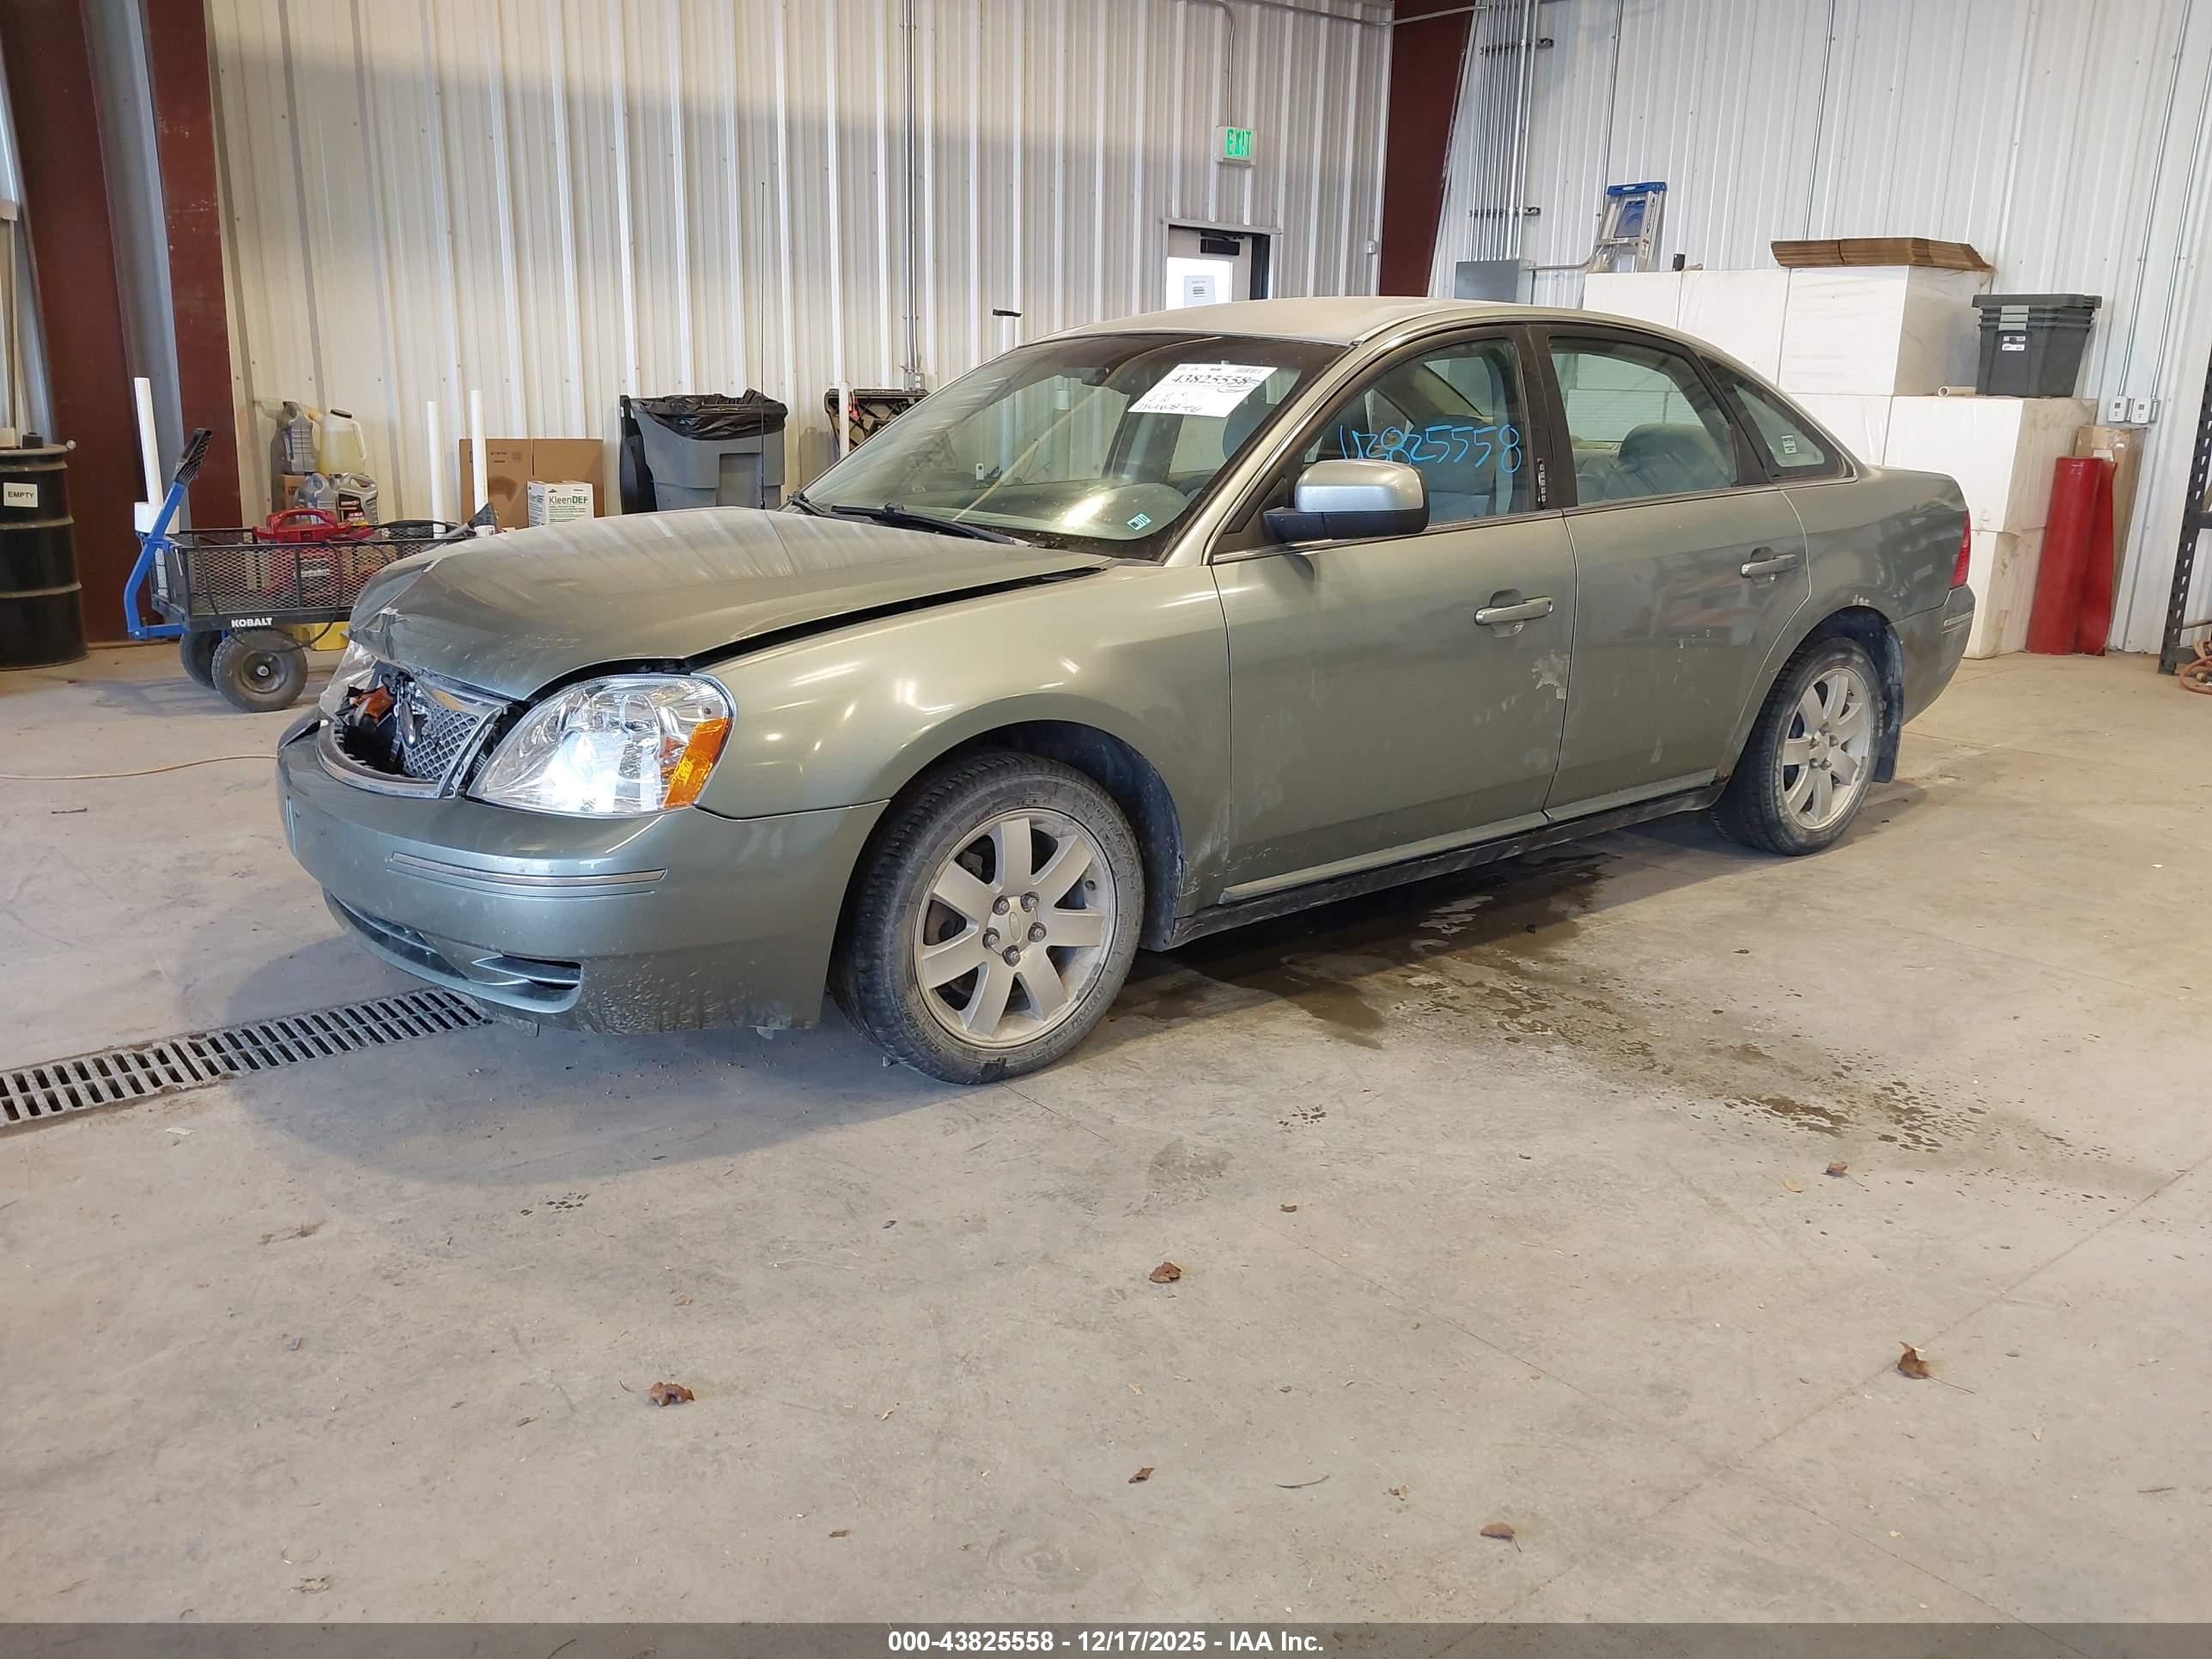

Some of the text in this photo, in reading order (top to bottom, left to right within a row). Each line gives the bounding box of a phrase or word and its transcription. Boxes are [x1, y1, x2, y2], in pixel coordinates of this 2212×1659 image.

[1226, 128, 1252, 156] EXIT
[1171, 374, 1252, 385] 43825558
[7, 490, 35, 499] EMPTY
[549, 495, 590, 505] KleenDEF
[231, 617, 273, 628] KOBALT
